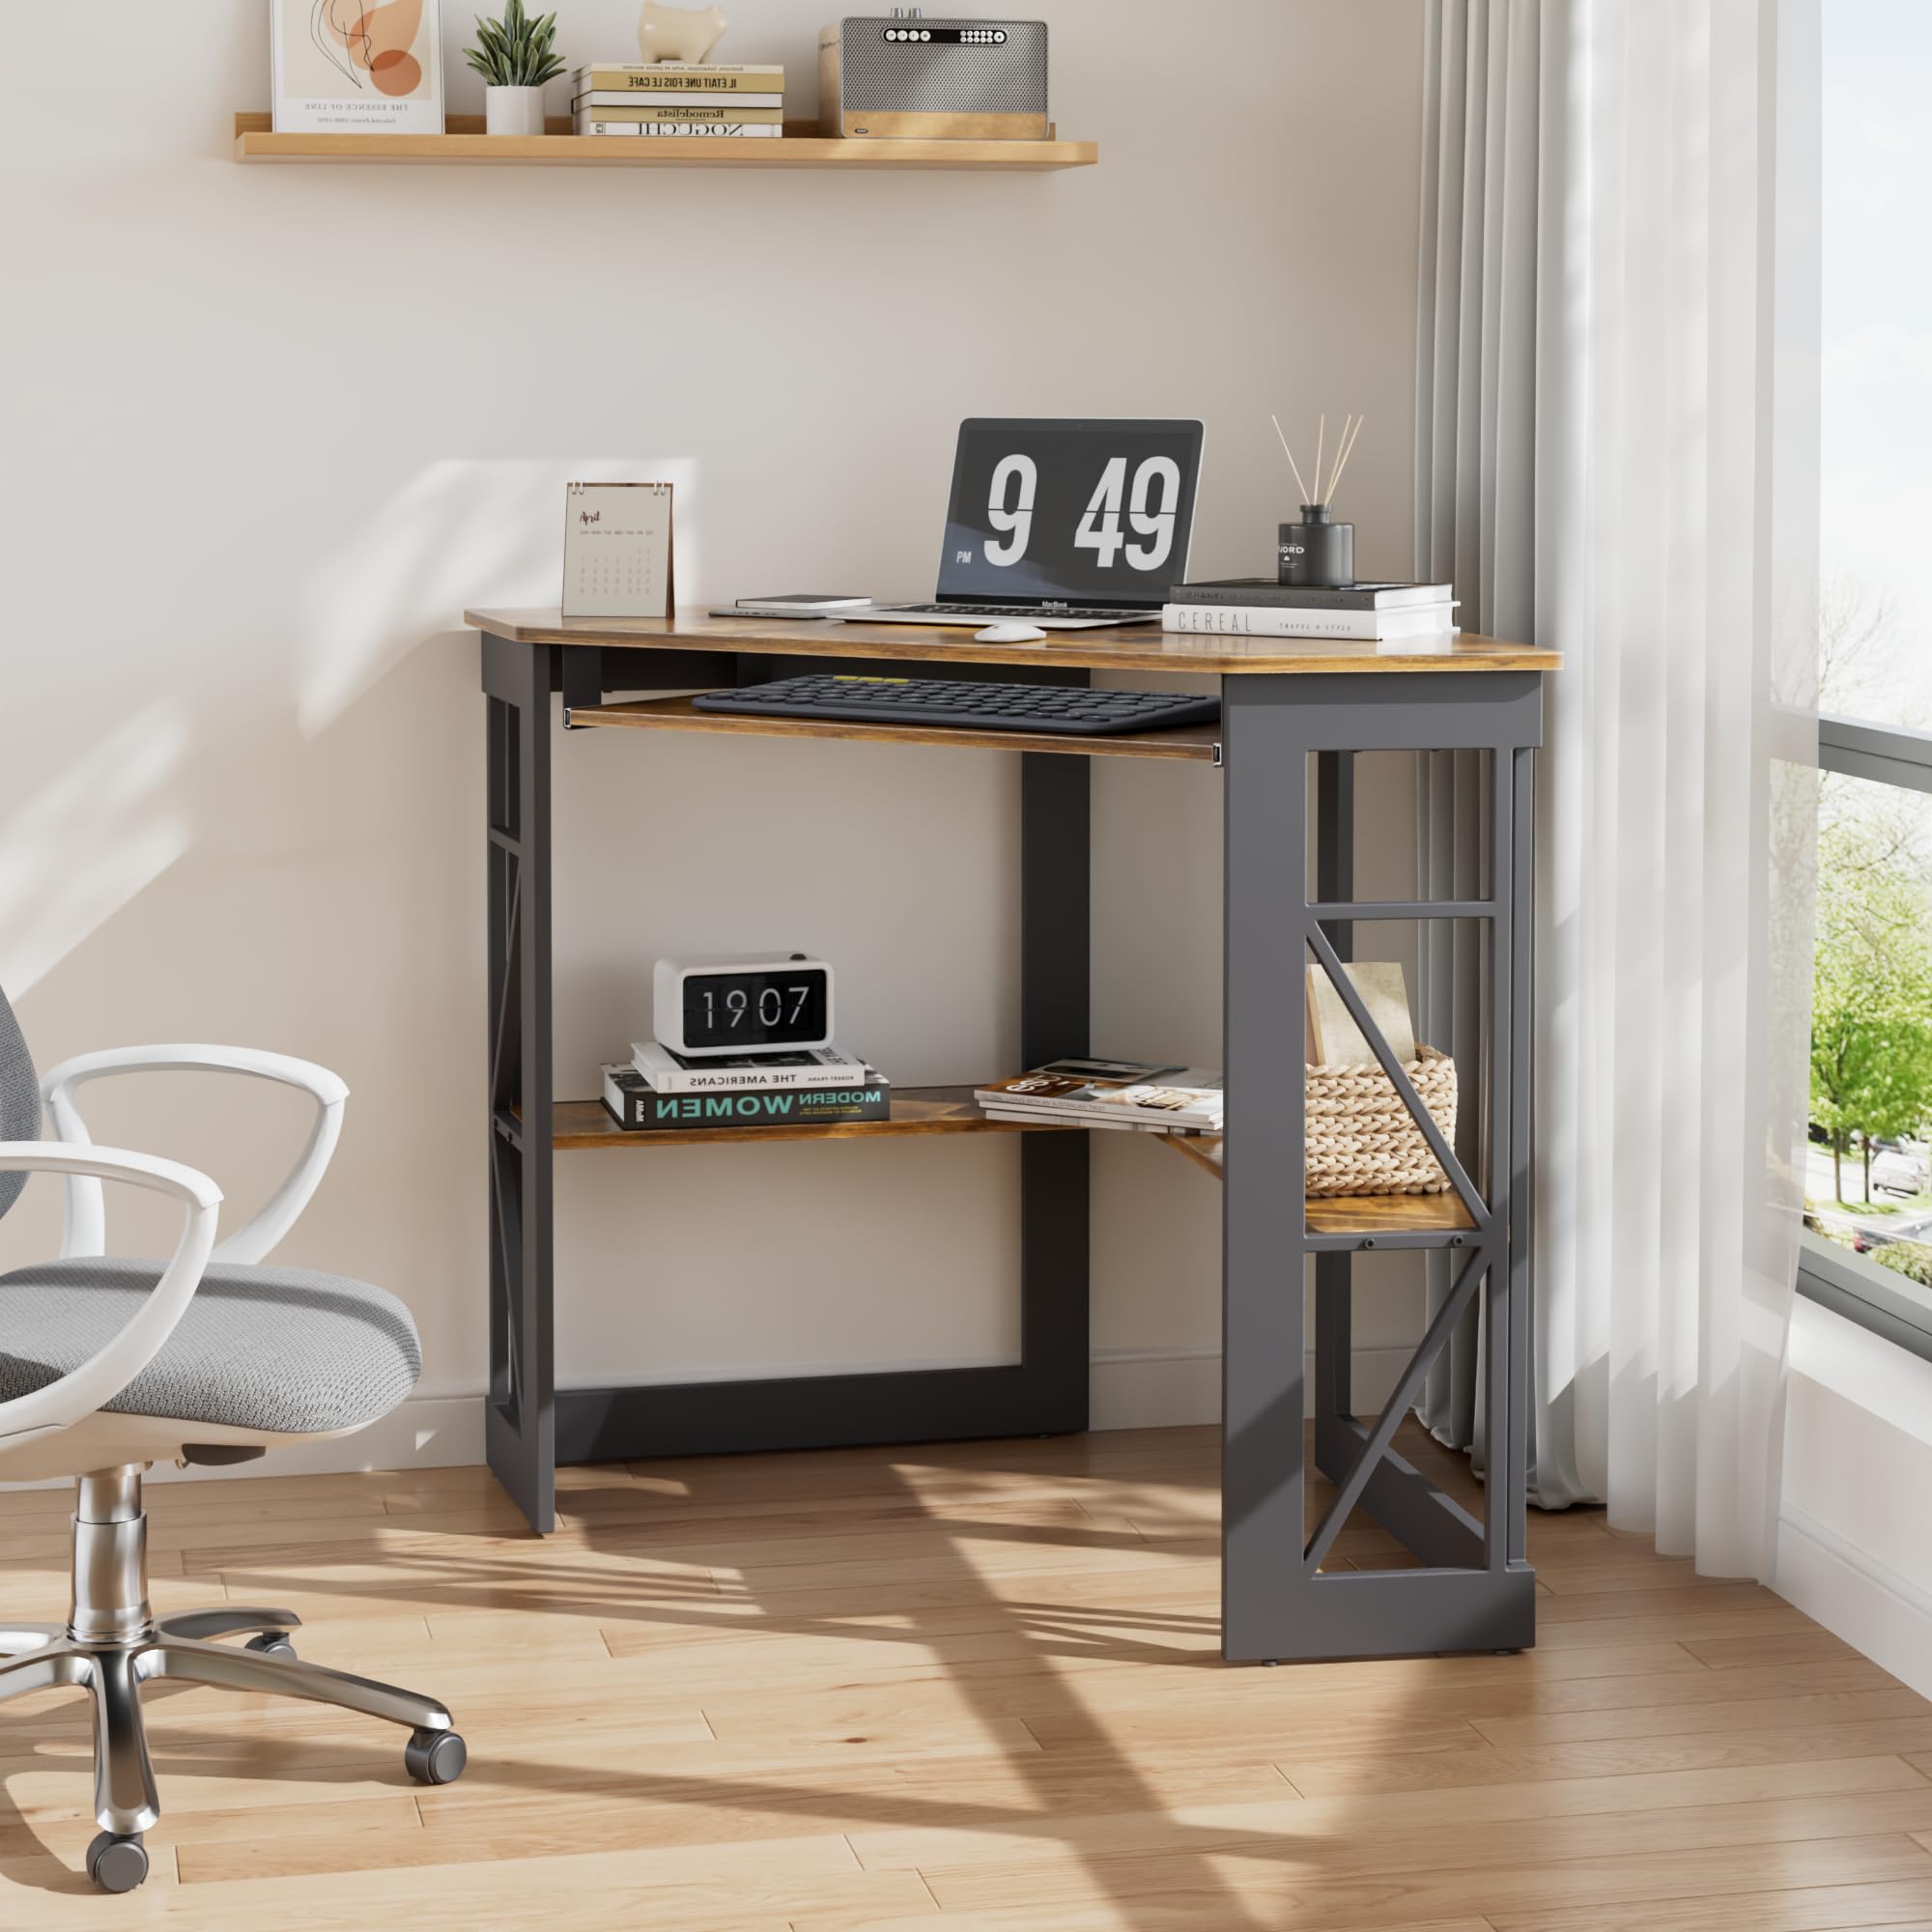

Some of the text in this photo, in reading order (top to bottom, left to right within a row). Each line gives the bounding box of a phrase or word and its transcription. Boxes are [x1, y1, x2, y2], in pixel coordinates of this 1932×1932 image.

[580, 510, 601, 526] April
[983, 454, 1180, 571] 9 49
[955, 551, 972, 564] PM
[1042, 601, 1067, 610] MacBook
[1179, 611, 1252, 633] CEREAL
[703, 986, 810, 1029] 1907
